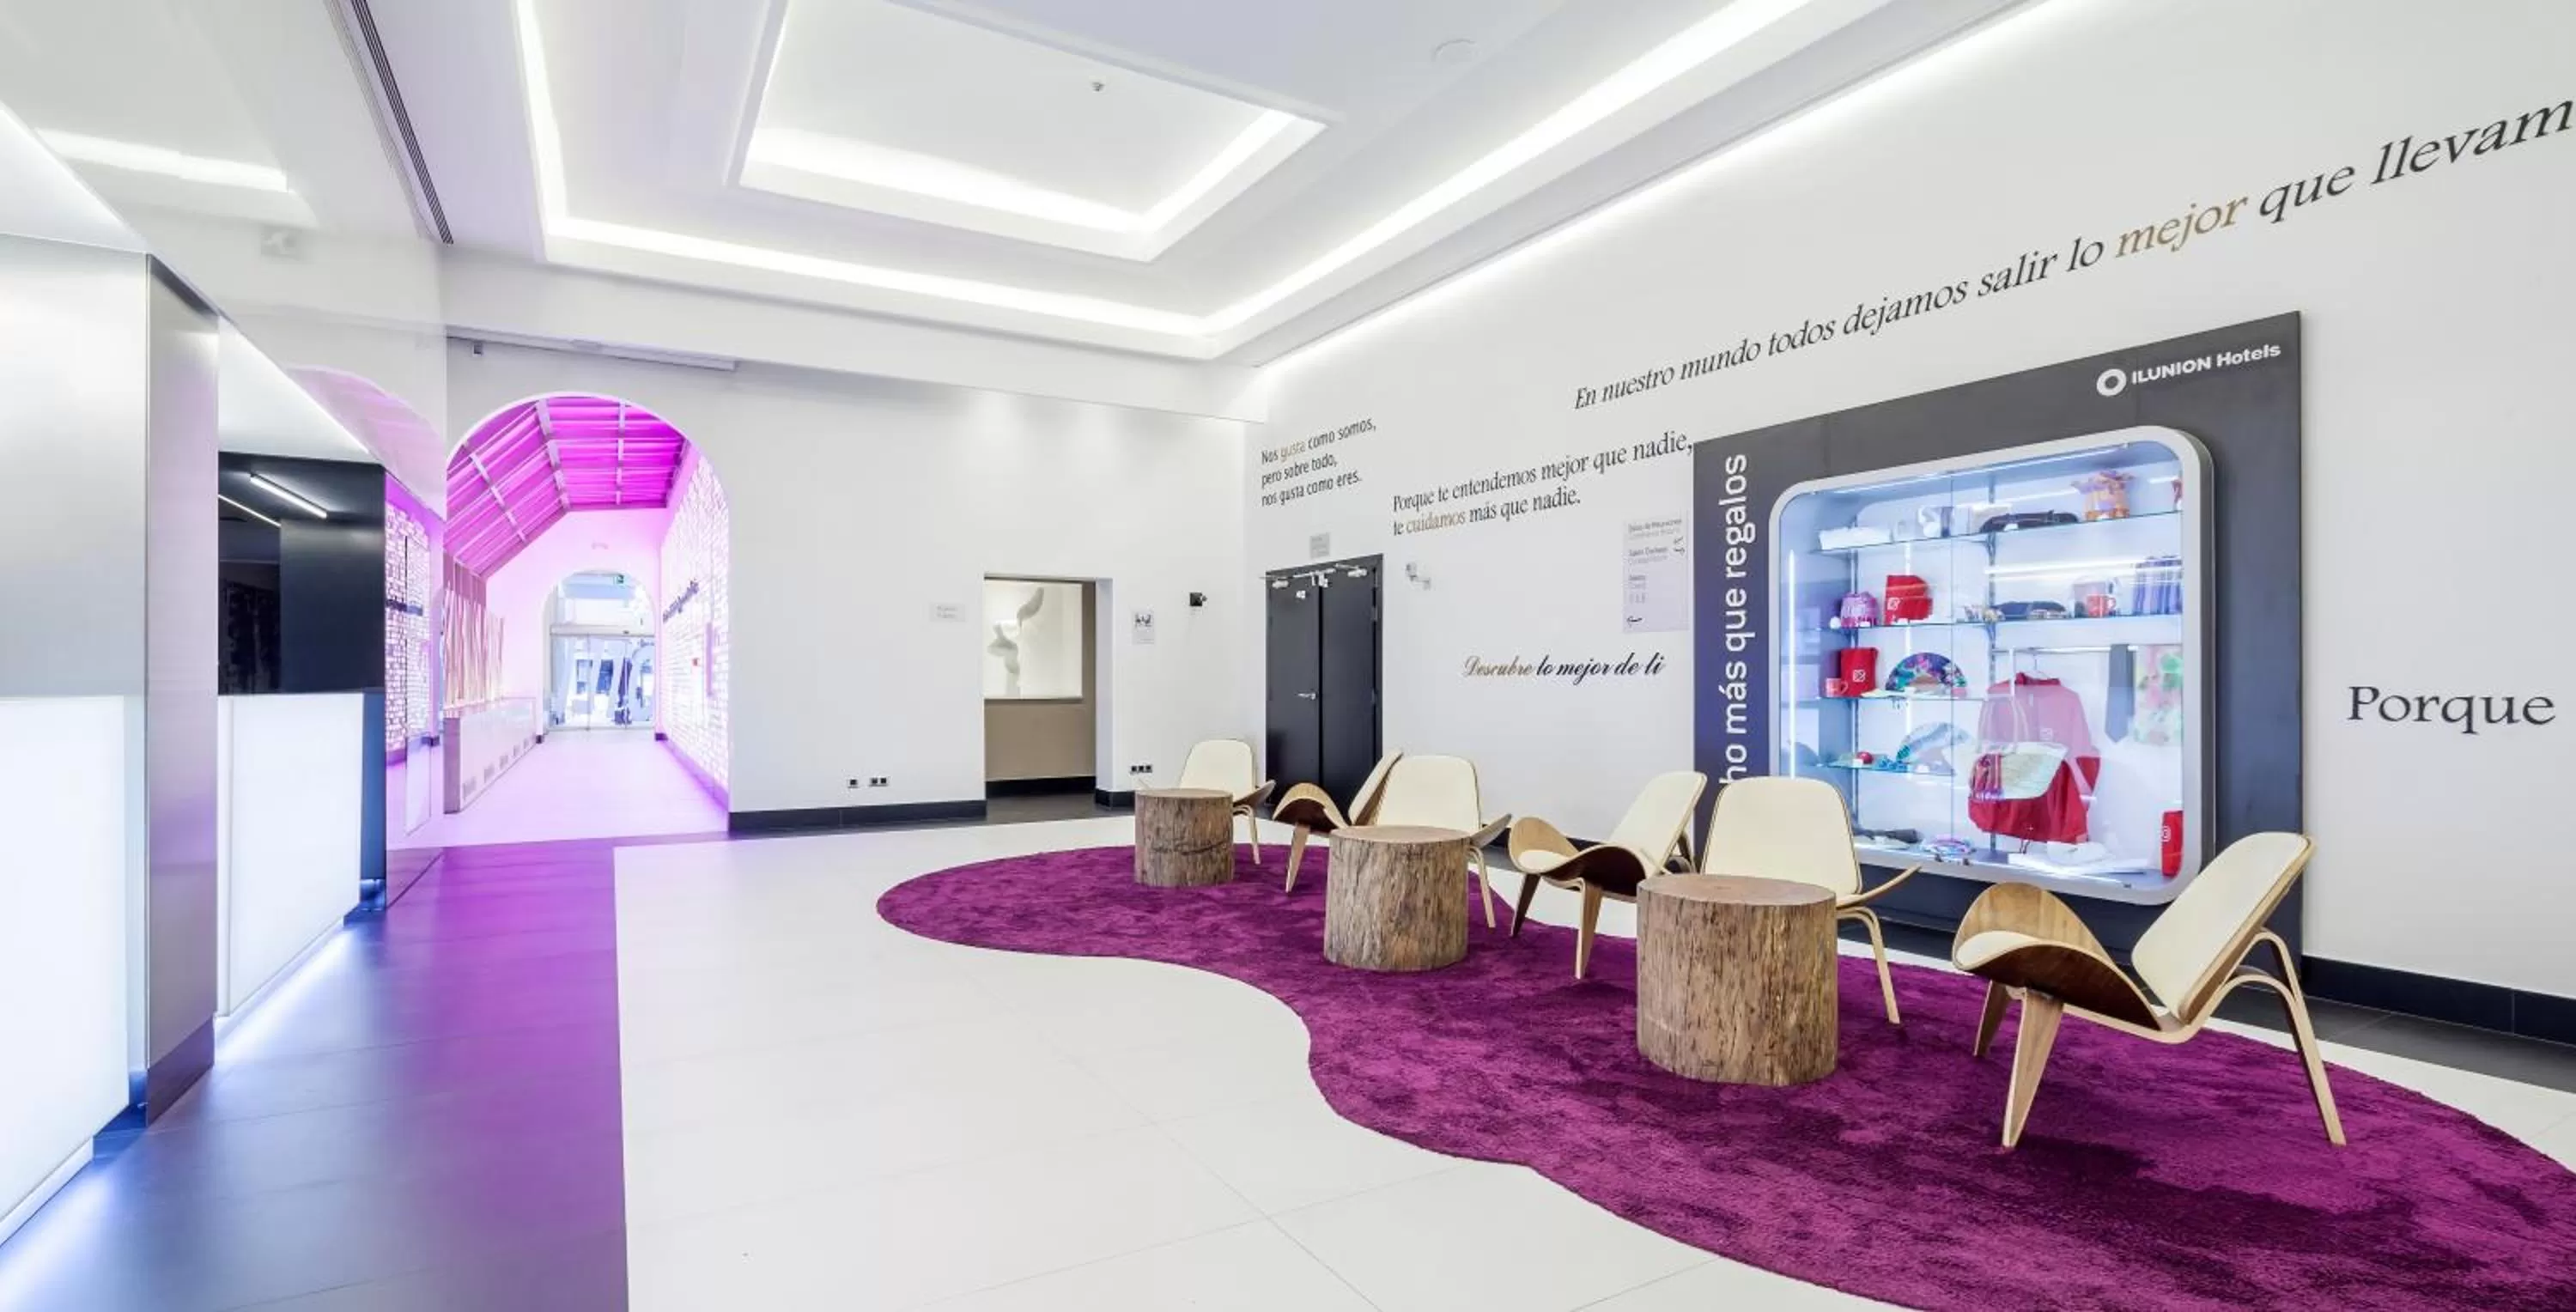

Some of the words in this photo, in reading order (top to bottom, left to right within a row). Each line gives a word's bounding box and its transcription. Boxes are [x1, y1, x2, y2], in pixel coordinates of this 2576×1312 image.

[1575, 387, 1596, 409] En
[1602, 367, 1674, 402] nuestro
[1680, 338, 1760, 380] mundo
[1769, 320, 1836, 356] todos
[1844, 282, 1968, 335] dejamos
[1978, 252, 2057, 296] salir
[2067, 235, 2104, 272] lo
[2116, 197, 2248, 258] mejor
[2260, 167, 2354, 223] que
[2372, 100, 2573, 184] llevam
[2132, 356, 2211, 384] ILUNION
[2217, 343, 2281, 367] Hotels
[1261, 450, 1278, 465] Nos
[1280, 440, 1305, 461] gusta
[1308, 431, 1335, 450] como
[1338, 419, 1376, 440] somos,
[1261, 471, 1282, 489] pero
[1285, 462, 1309, 480] sobre
[1312, 453, 1338, 471] todo,
[1261, 492, 1280, 507] nos
[1279, 486, 1304, 505] gusta
[1307, 478, 1334, 495] como
[1337, 471, 1362, 487] eres.
[1394, 491, 1434, 512] Porque
[1438, 487, 1449, 501] te
[1453, 469, 1536, 499] entendemos
[1542, 456, 1589, 480] mejor
[1594, 447, 1627, 474] que
[1633, 430, 1693, 460] nadie,
[1394, 521, 1404, 536] te
[1406, 512, 1466, 533] cuidamos
[1470, 504, 1498, 523] más
[1501, 500, 1528, 522] que
[1534, 486, 1580, 511] nadie.
[1718, 454, 1755, 578] regalos
[1726, 589, 1755, 651] que
[1465, 656, 1533, 676] Descubre
[1536, 655, 1553, 676] lo
[1556, 659, 1614, 685] mejor
[1614, 652, 1639, 676] de
[1717, 661, 1747, 734] más
[2348, 687, 2555, 734] Porque
